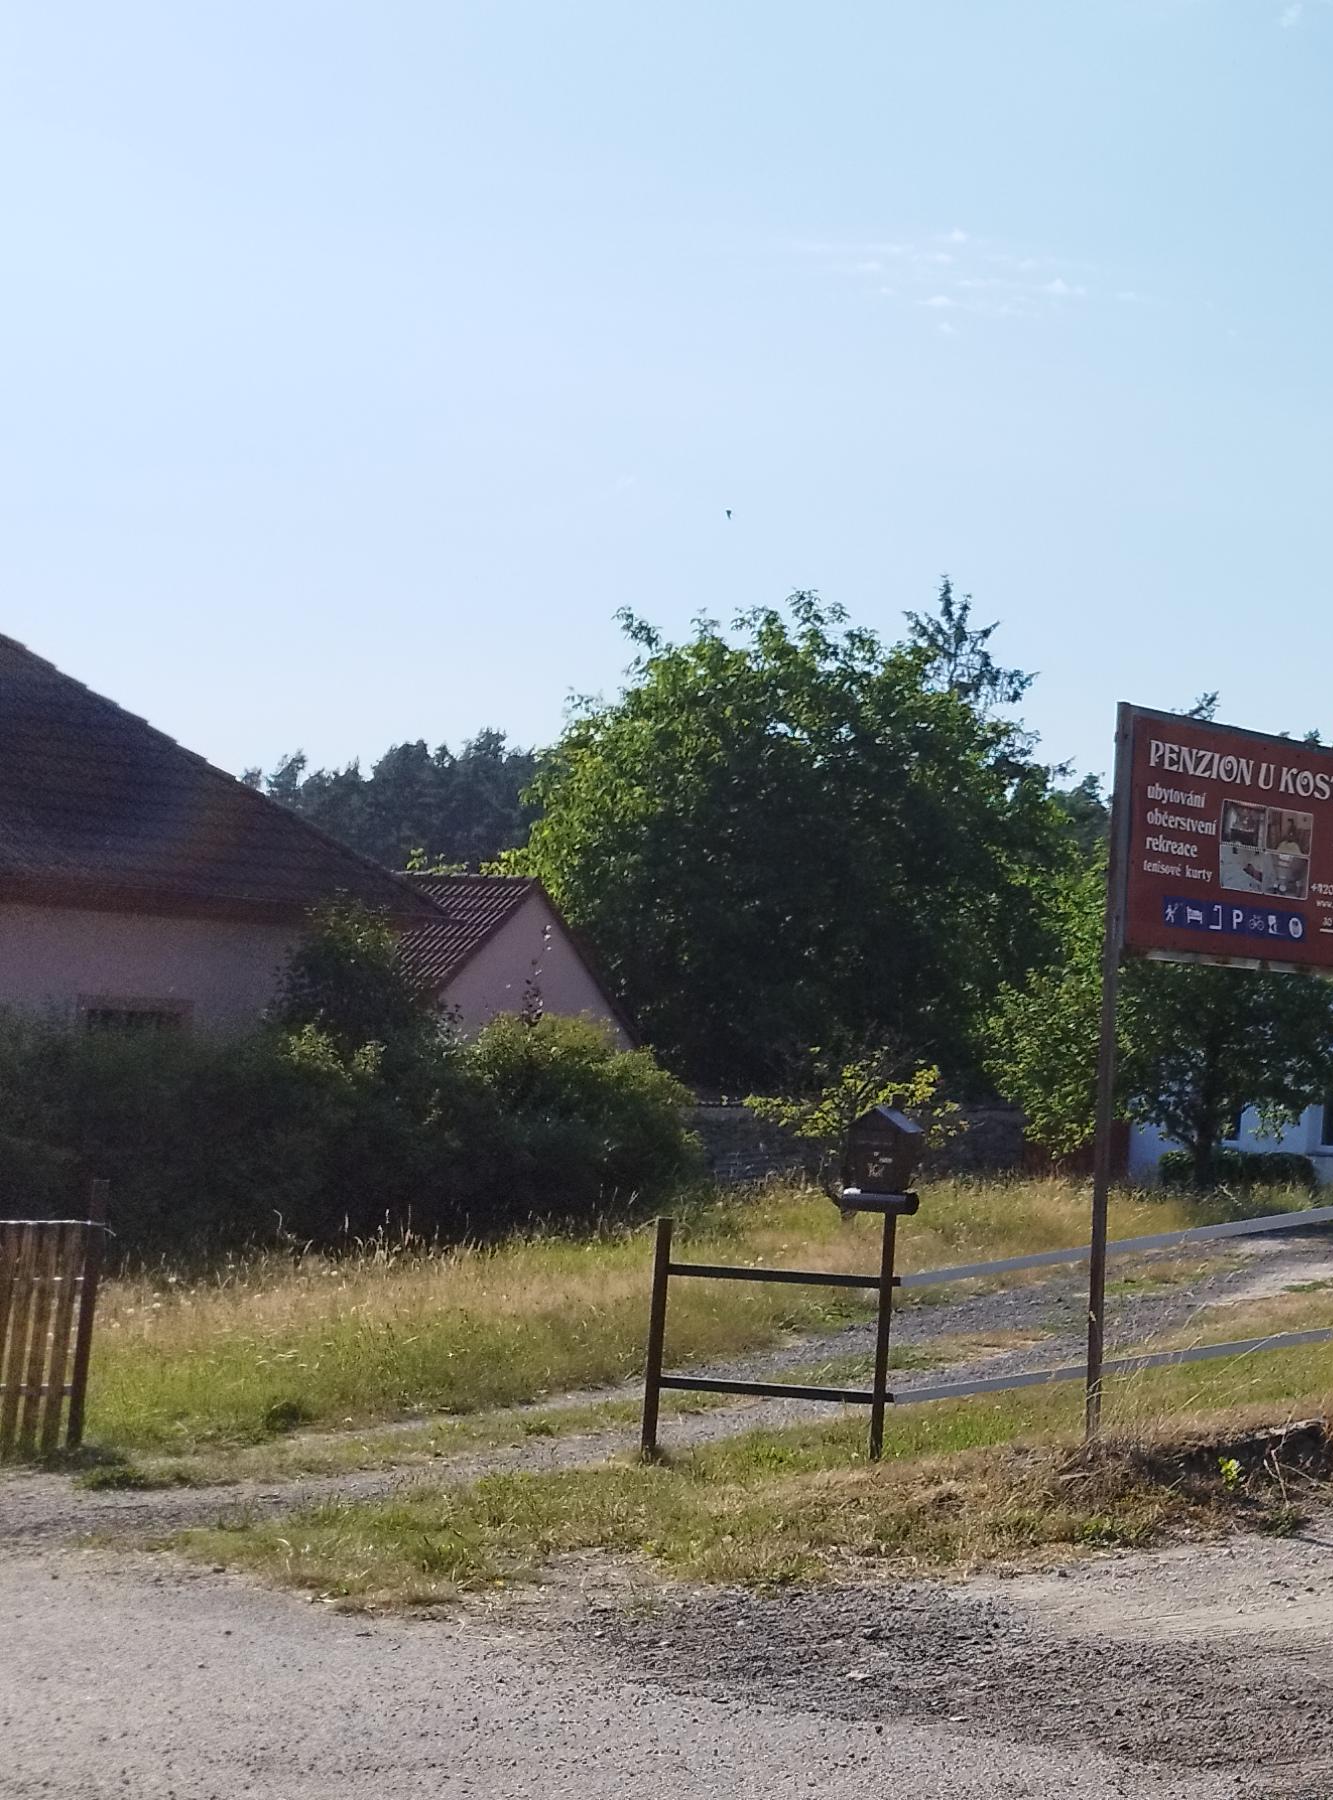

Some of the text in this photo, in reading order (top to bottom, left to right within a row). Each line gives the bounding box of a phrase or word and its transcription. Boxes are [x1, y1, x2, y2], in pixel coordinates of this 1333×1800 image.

[1150, 740, 1253, 786] PENZION
[1258, 761, 1274, 790] U
[1147, 782, 1207, 808] ubytování
[1147, 808, 1217, 835] občerstvení
[1145, 834, 1198, 858] rekreace
[1143, 860, 1213, 882] tenisové kurty
[1232, 909, 1243, 930] P
